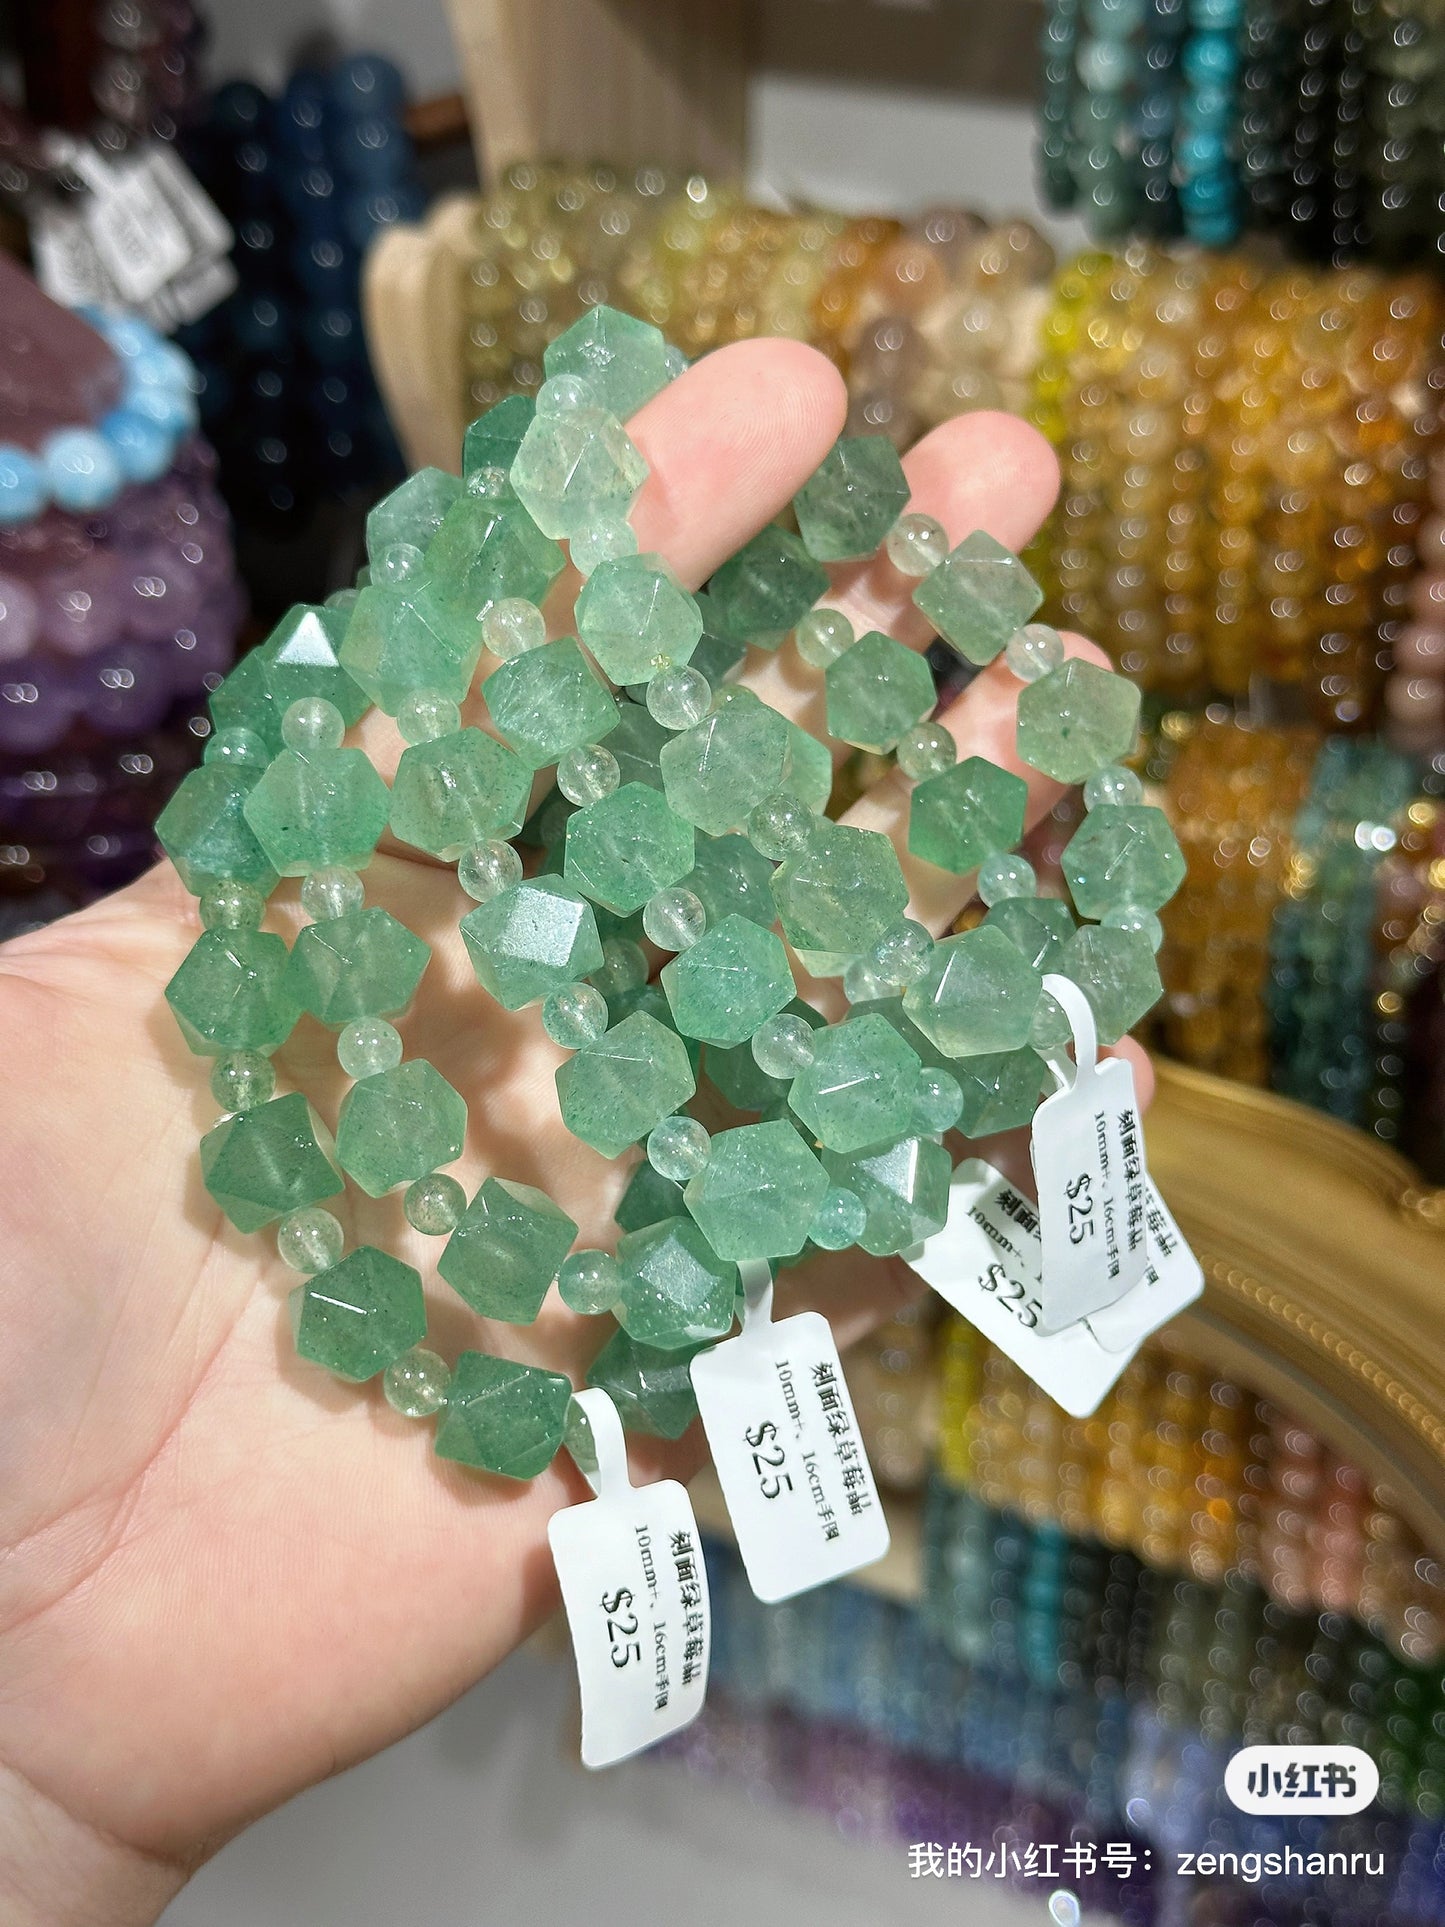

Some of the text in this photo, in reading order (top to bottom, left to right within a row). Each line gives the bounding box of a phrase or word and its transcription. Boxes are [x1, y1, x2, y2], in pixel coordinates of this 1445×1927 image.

[1063, 1173, 1095, 1245] $25
[978, 1263, 1043, 1328] $25
[742, 1420, 794, 1499] $25
[809, 1360, 872, 1516] 刻面绿草莓晶
[599, 1586, 642, 1668] $25
[668, 1529, 704, 1685] 刻面绿草莓晶
